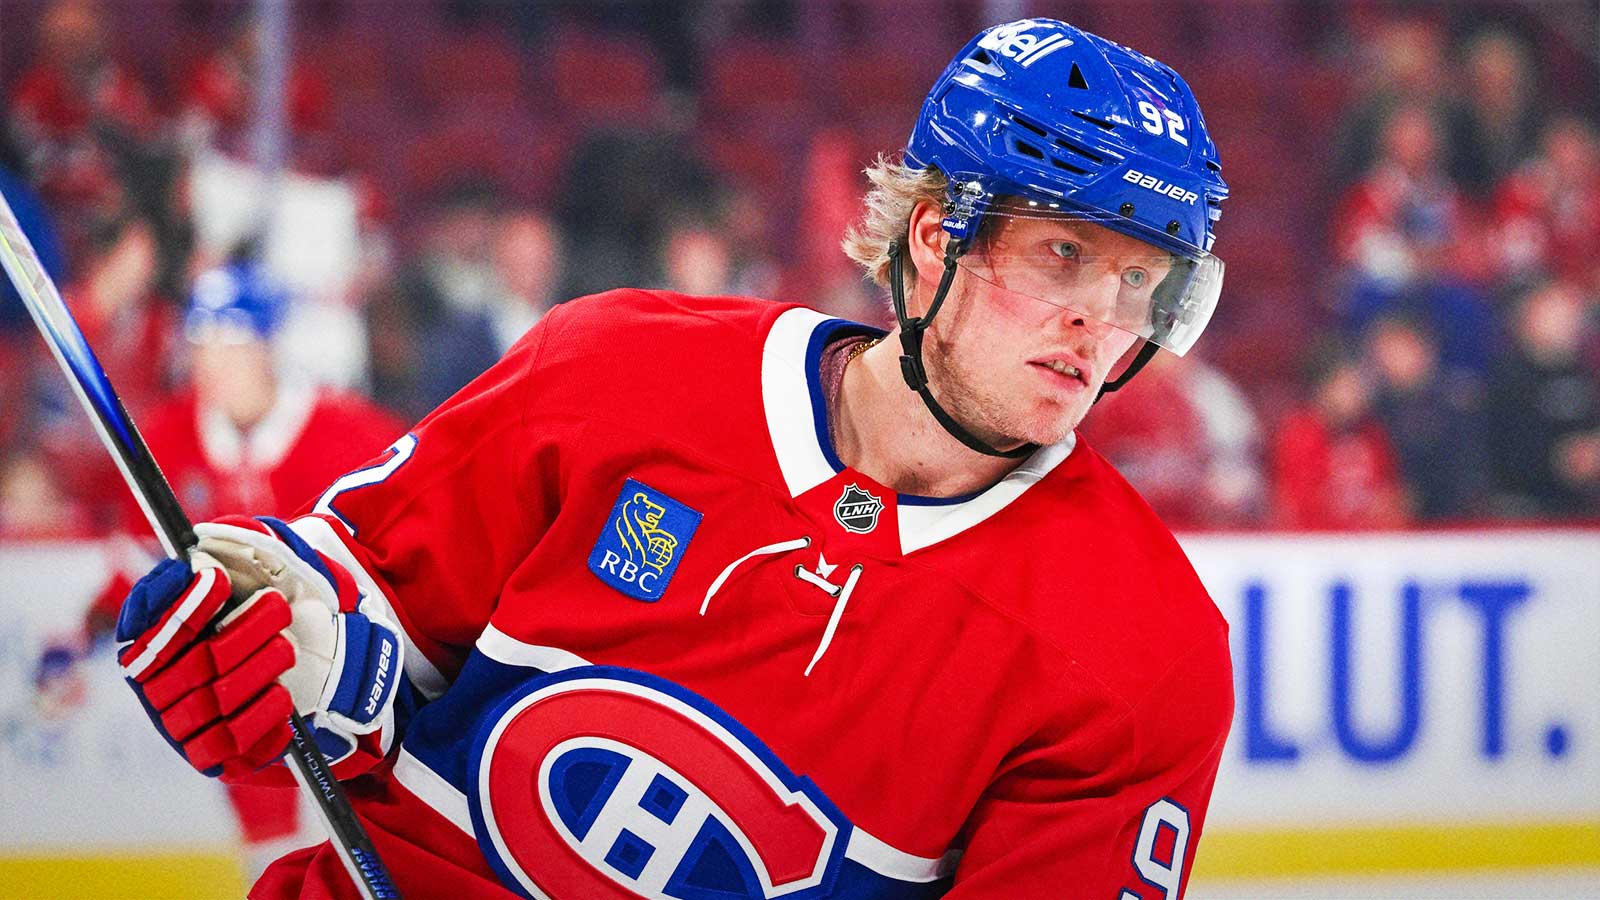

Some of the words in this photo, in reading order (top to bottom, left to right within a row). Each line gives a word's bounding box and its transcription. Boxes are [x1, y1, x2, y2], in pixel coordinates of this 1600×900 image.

[1138, 101, 1188, 147] 92
[1122, 169, 1199, 206] BAUER
[841, 503, 876, 517] LNH
[598, 549, 659, 593] RBC
[364, 638, 392, 716] BAUER
[304, 751, 336, 802] TWITCH
